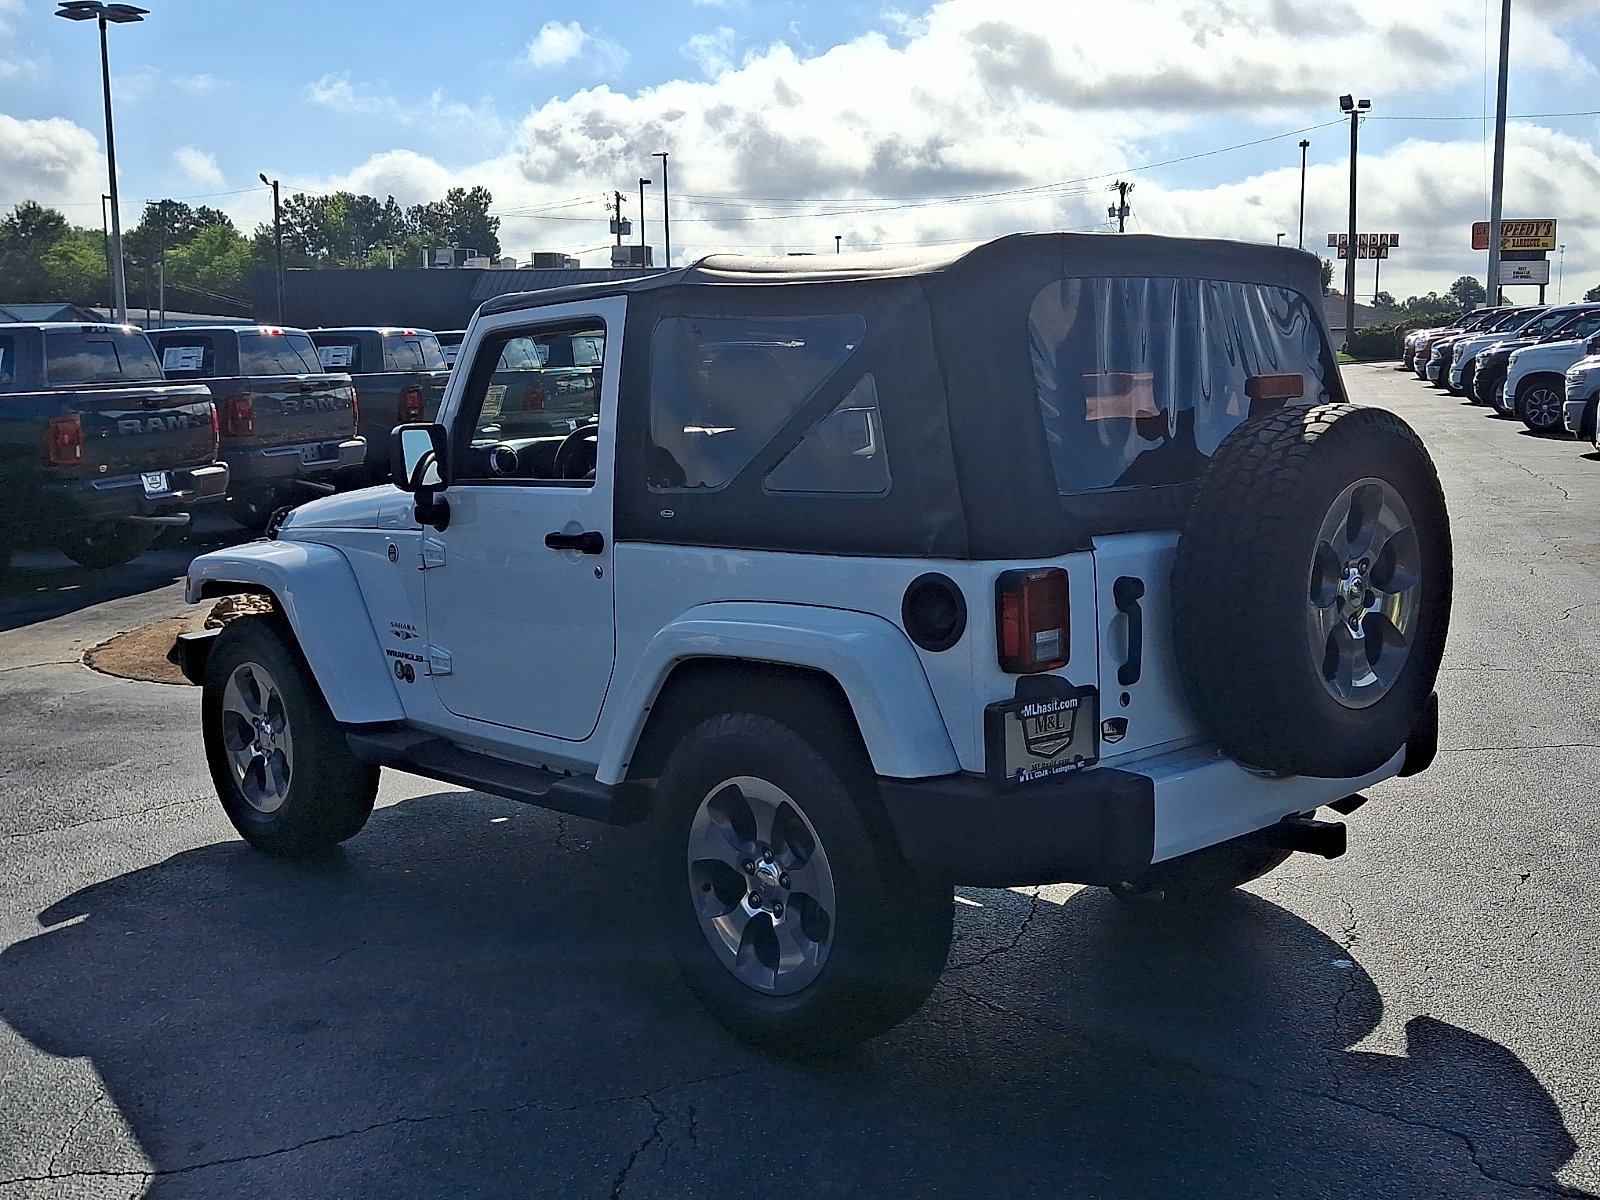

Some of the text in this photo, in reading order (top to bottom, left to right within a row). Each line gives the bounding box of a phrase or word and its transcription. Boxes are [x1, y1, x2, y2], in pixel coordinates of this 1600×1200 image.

[1339, 234, 1388, 245] PNDA
[1338, 248, 1388, 258] PNDA
[280, 397, 335, 413] RAM
[117, 414, 190, 434] RAM
[390, 621, 417, 631] SAHARA
[1023, 698, 1078, 717] MLhasit.com
[1034, 712, 1065, 734] M&L
